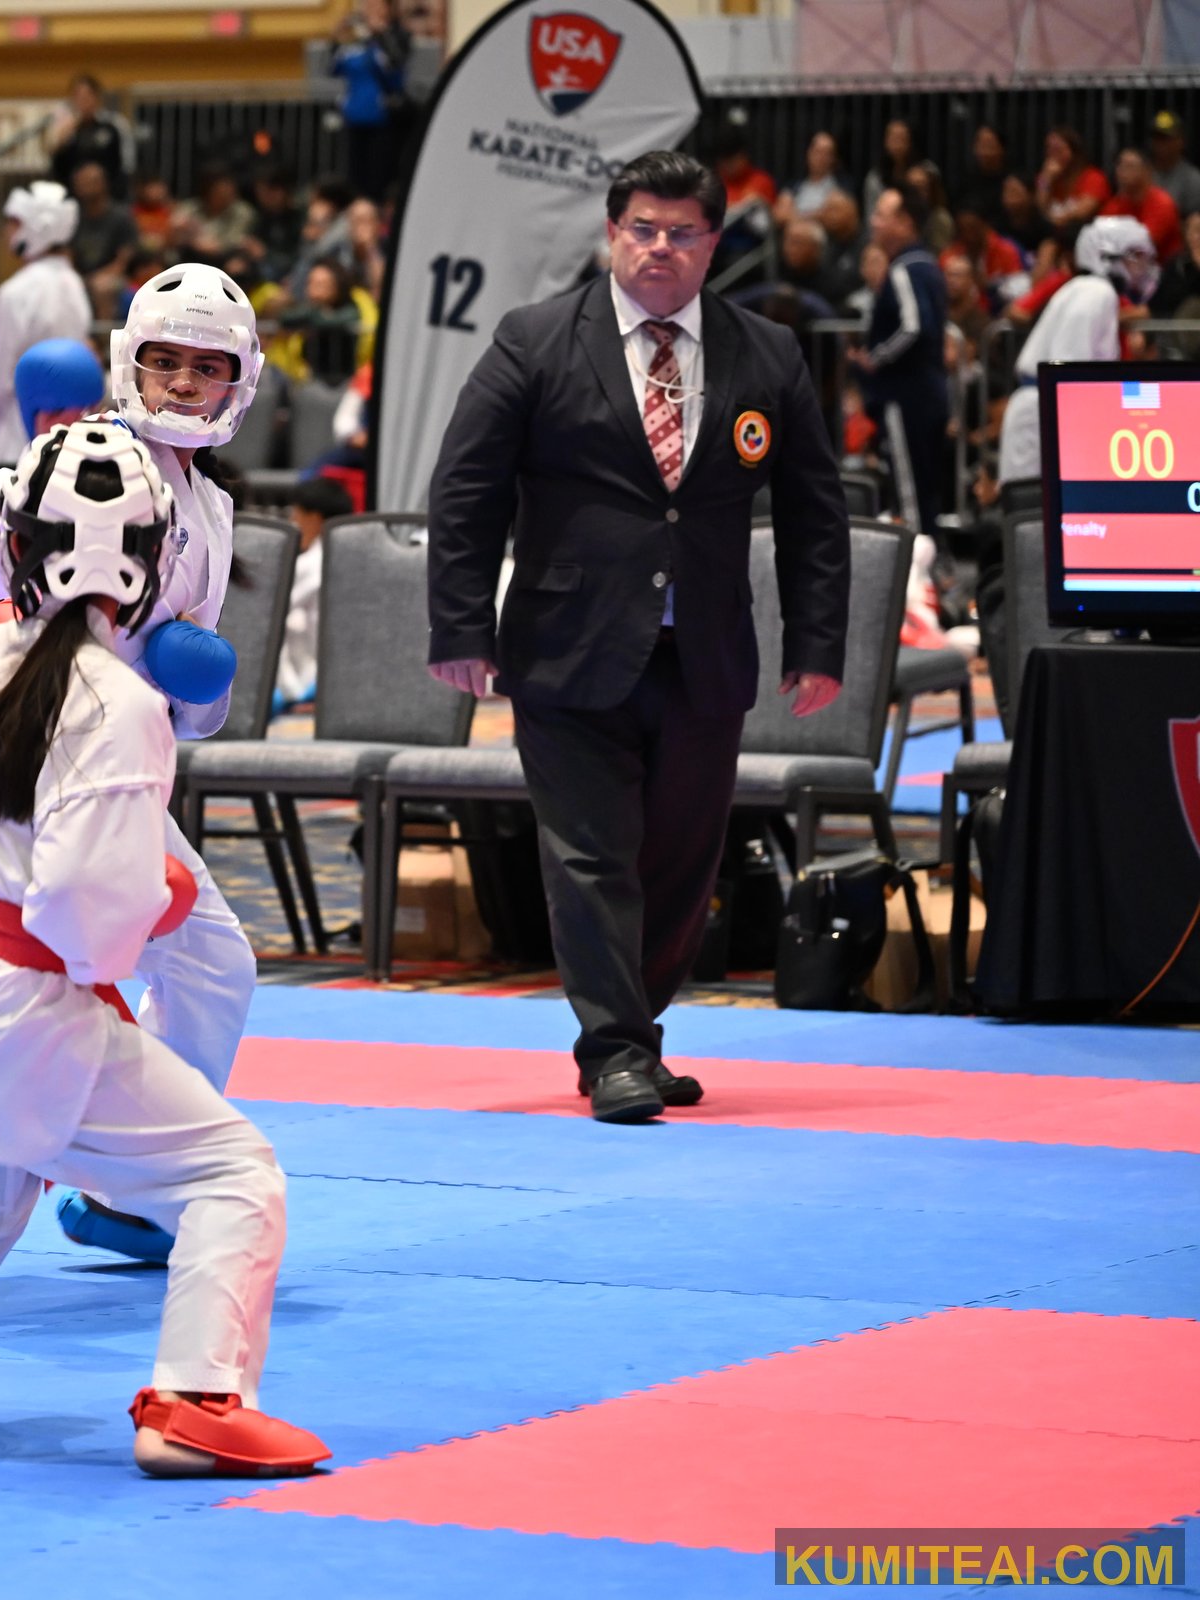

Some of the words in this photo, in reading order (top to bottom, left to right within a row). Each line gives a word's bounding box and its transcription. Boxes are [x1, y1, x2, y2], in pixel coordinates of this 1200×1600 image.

[538, 23, 605, 65] USA
[469, 128, 628, 180] KARATE-DO
[185, 307, 214, 317] APPROVED
[427, 254, 486, 333] 12
[1109, 429, 1174, 480] 00
